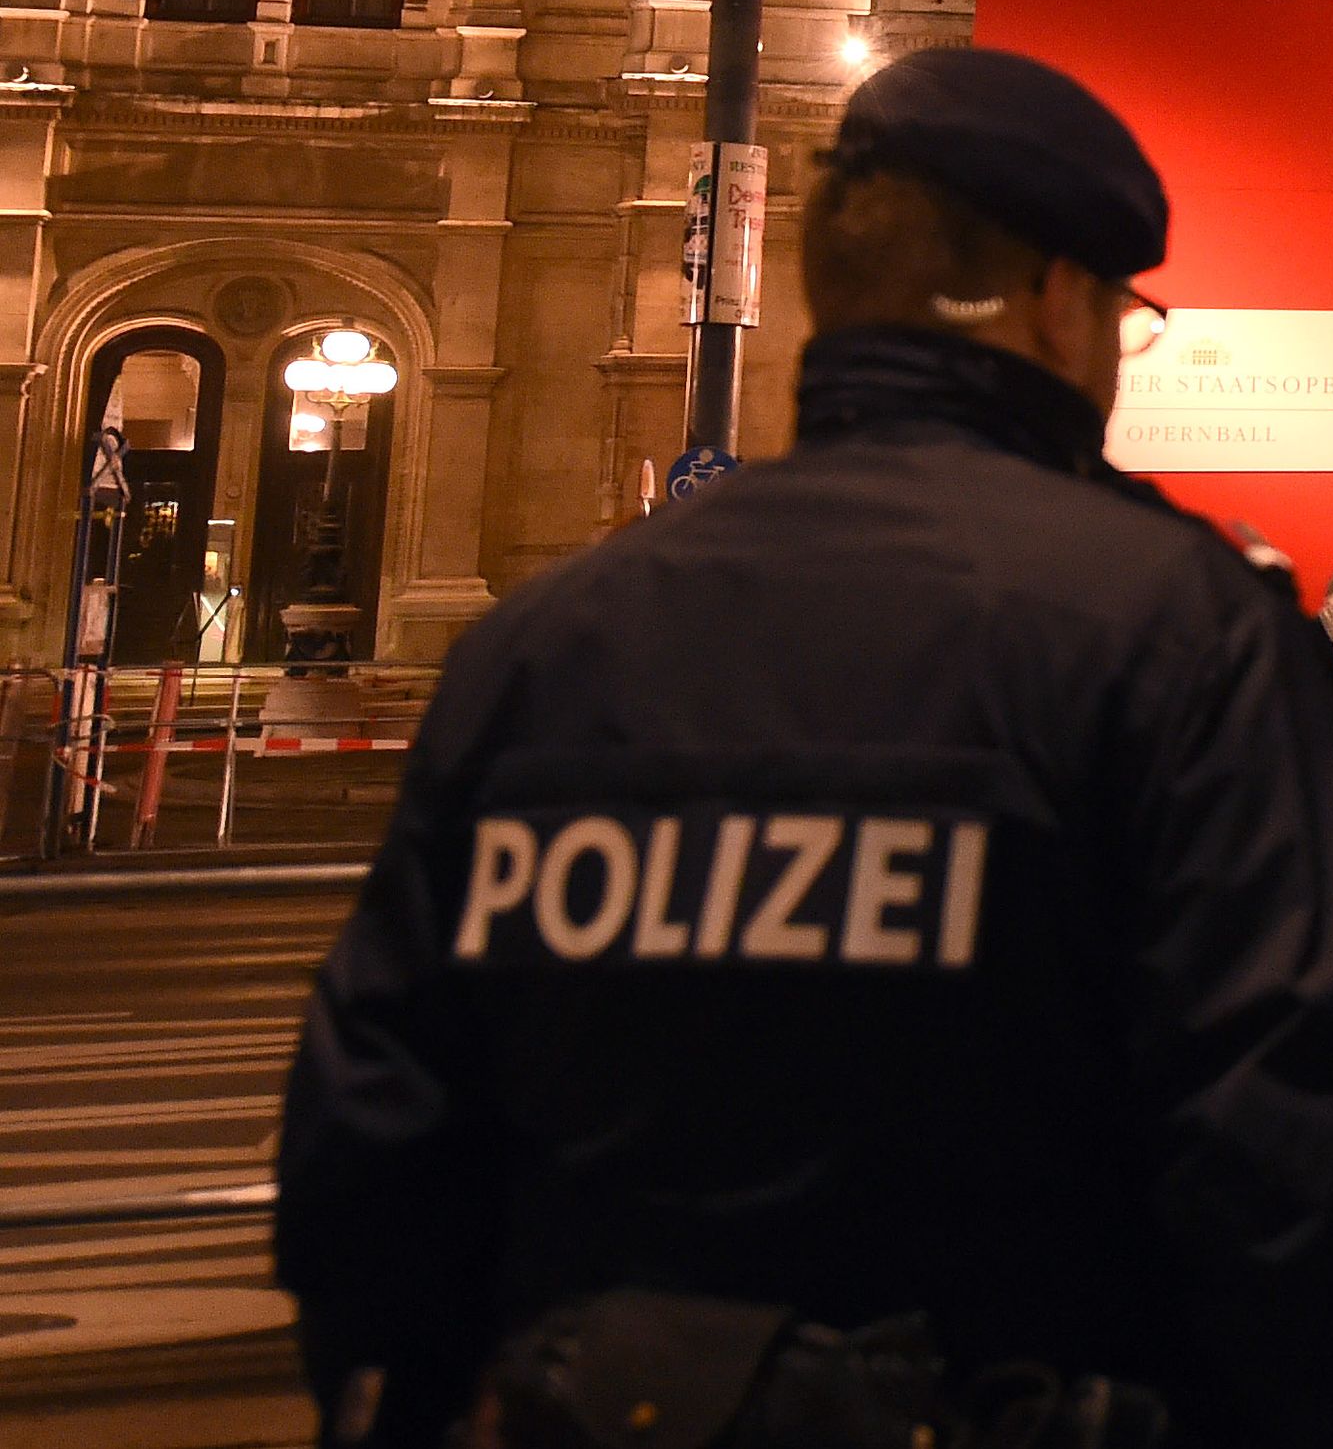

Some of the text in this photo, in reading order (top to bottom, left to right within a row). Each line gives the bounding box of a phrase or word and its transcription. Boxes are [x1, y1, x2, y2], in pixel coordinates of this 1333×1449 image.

[1118, 374, 1163, 394] ER
[1127, 426, 1278, 444] OPERNBALL
[453, 815, 989, 968] POLIZEI
